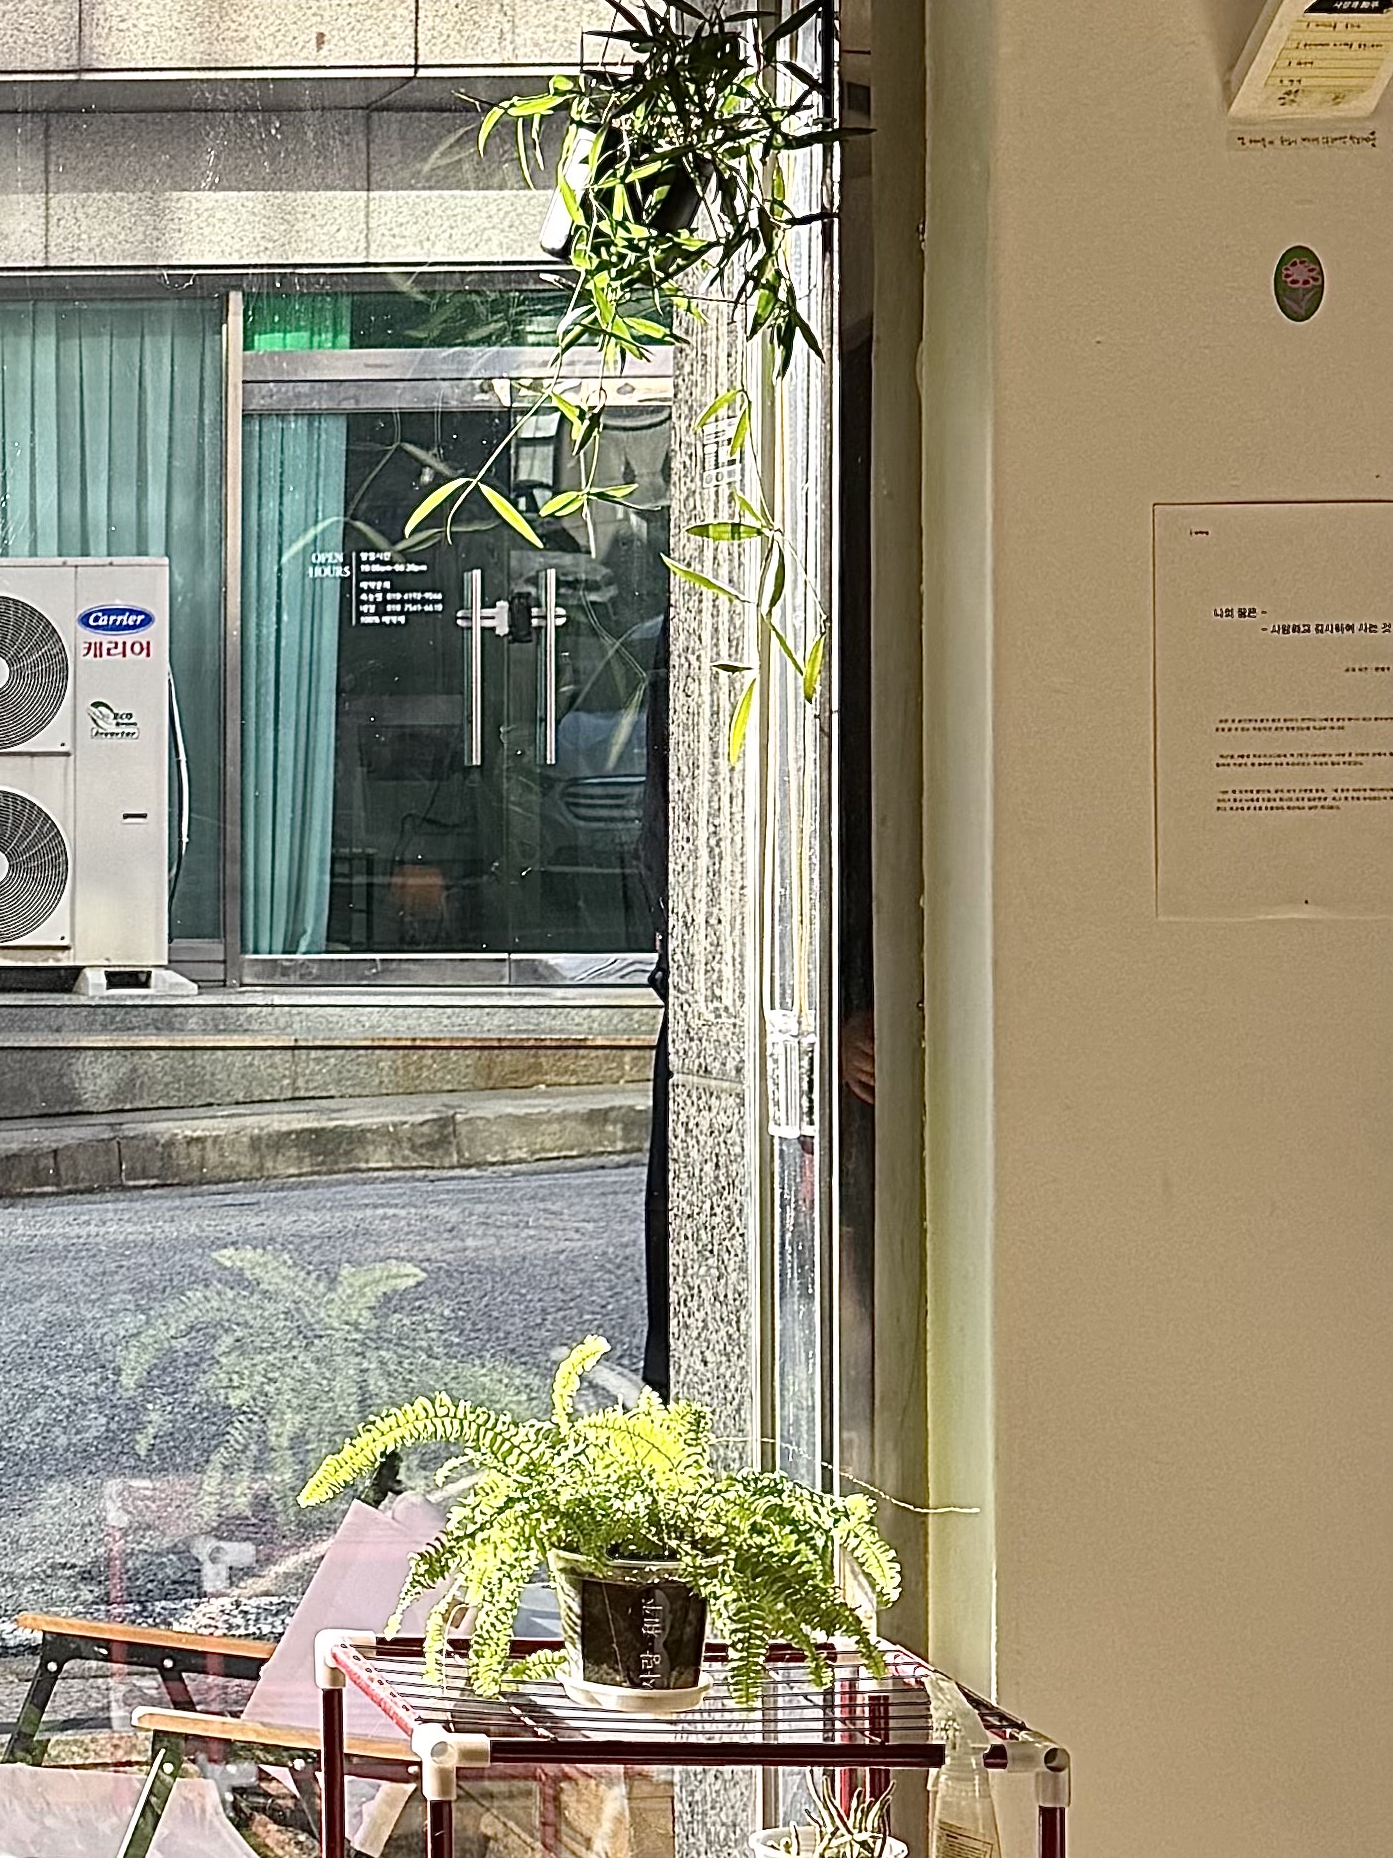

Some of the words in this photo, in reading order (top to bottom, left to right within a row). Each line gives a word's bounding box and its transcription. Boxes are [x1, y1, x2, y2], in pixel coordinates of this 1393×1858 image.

[311, 552, 344, 564] OPEN
[308, 565, 351, 578] HOURS
[88, 611, 145, 626] Carrier
[82, 640, 151, 658] 캐리어
